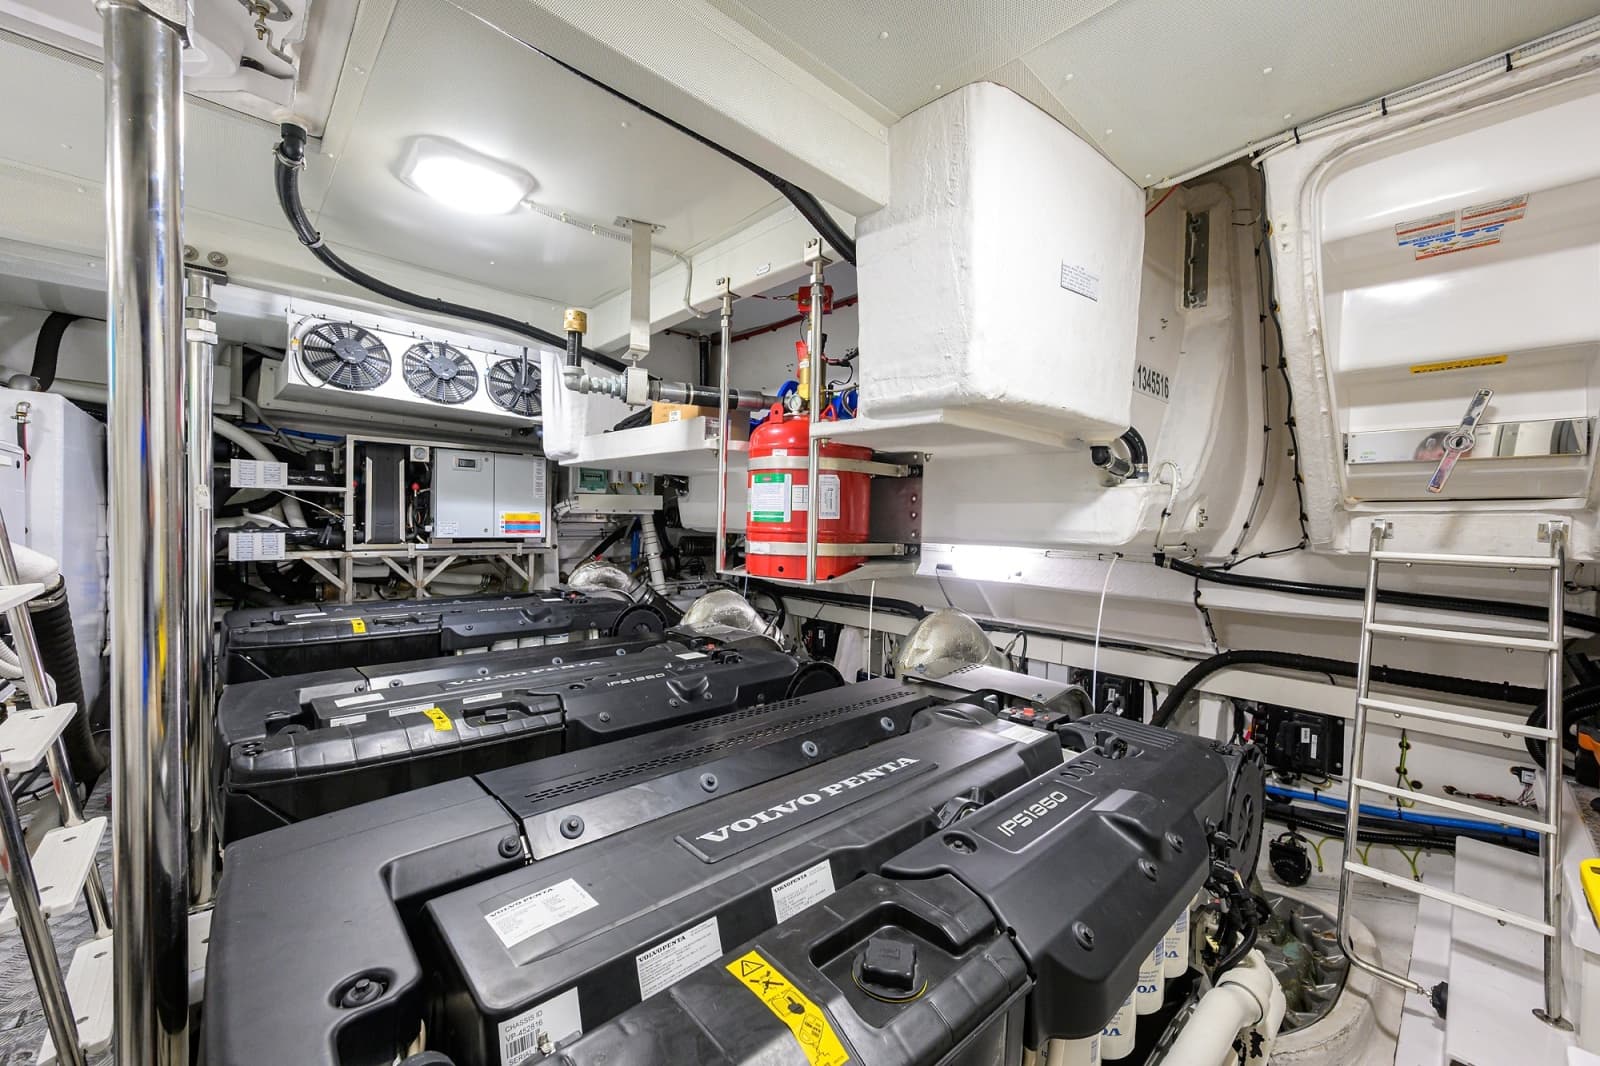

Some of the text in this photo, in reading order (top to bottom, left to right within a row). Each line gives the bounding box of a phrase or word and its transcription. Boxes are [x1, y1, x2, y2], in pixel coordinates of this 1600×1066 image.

[1137, 364, 1169, 399] 1345516
[447, 661, 603, 686] VOLVO PENTA
[695, 757, 921, 842] VOLVO PENTA
[997, 791, 1068, 837] IPS1350
[504, 1009, 543, 1033] CHASSIS ID
[505, 1019, 543, 1042] VP-452816
